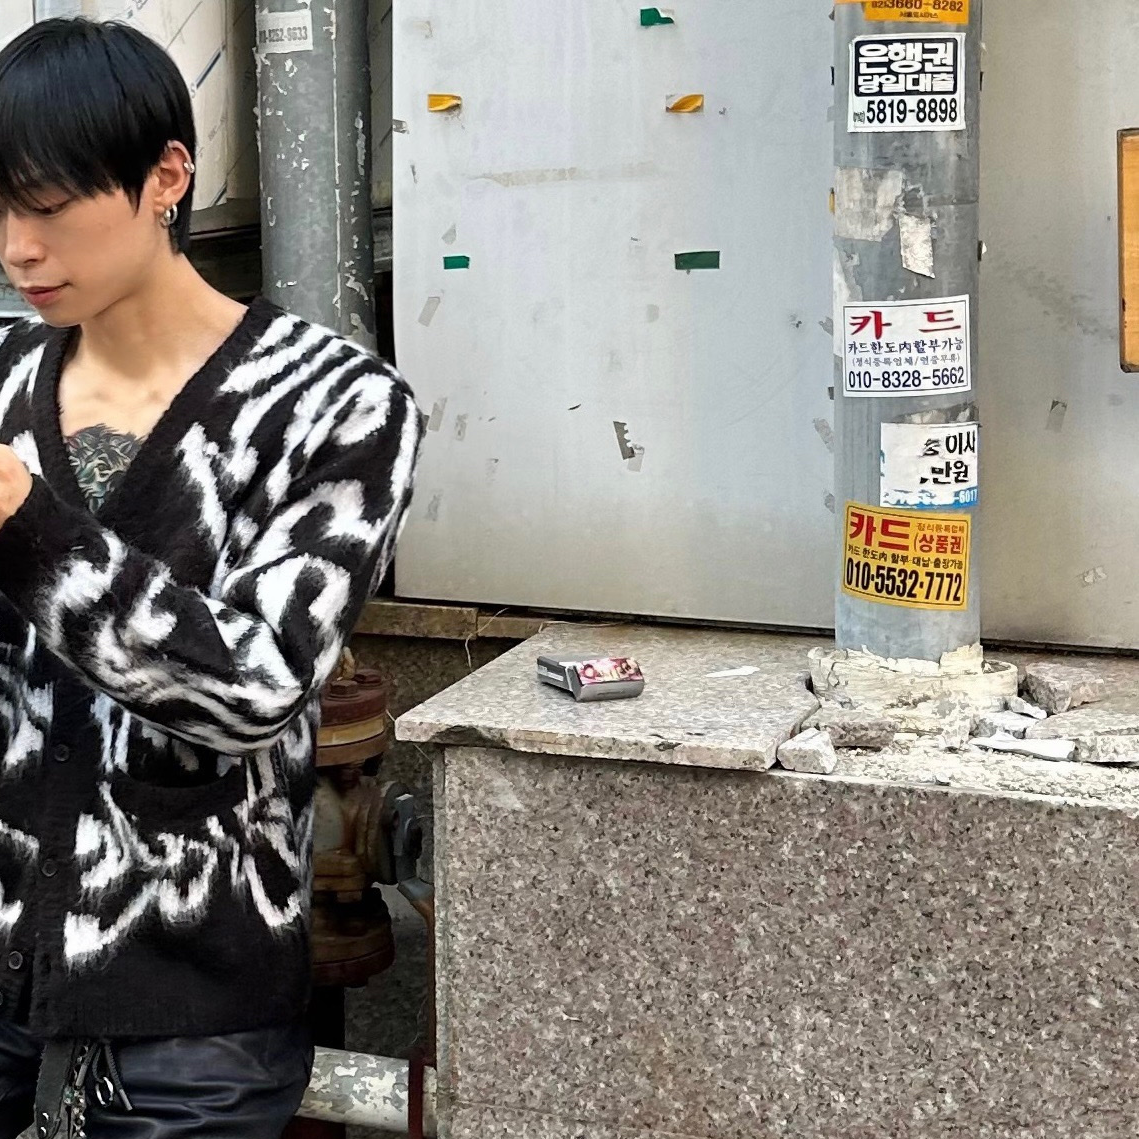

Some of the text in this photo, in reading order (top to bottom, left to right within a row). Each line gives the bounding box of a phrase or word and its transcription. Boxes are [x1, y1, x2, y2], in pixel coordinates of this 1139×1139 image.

[858, 42, 954, 74] 은행권
[857, 72, 955, 94] 당일대출
[866, 97, 958, 124] 5819-8898
[848, 366, 965, 389] 010-8328-5662
[849, 511, 911, 552] 카드
[913, 532, 965, 555] (상품권)
